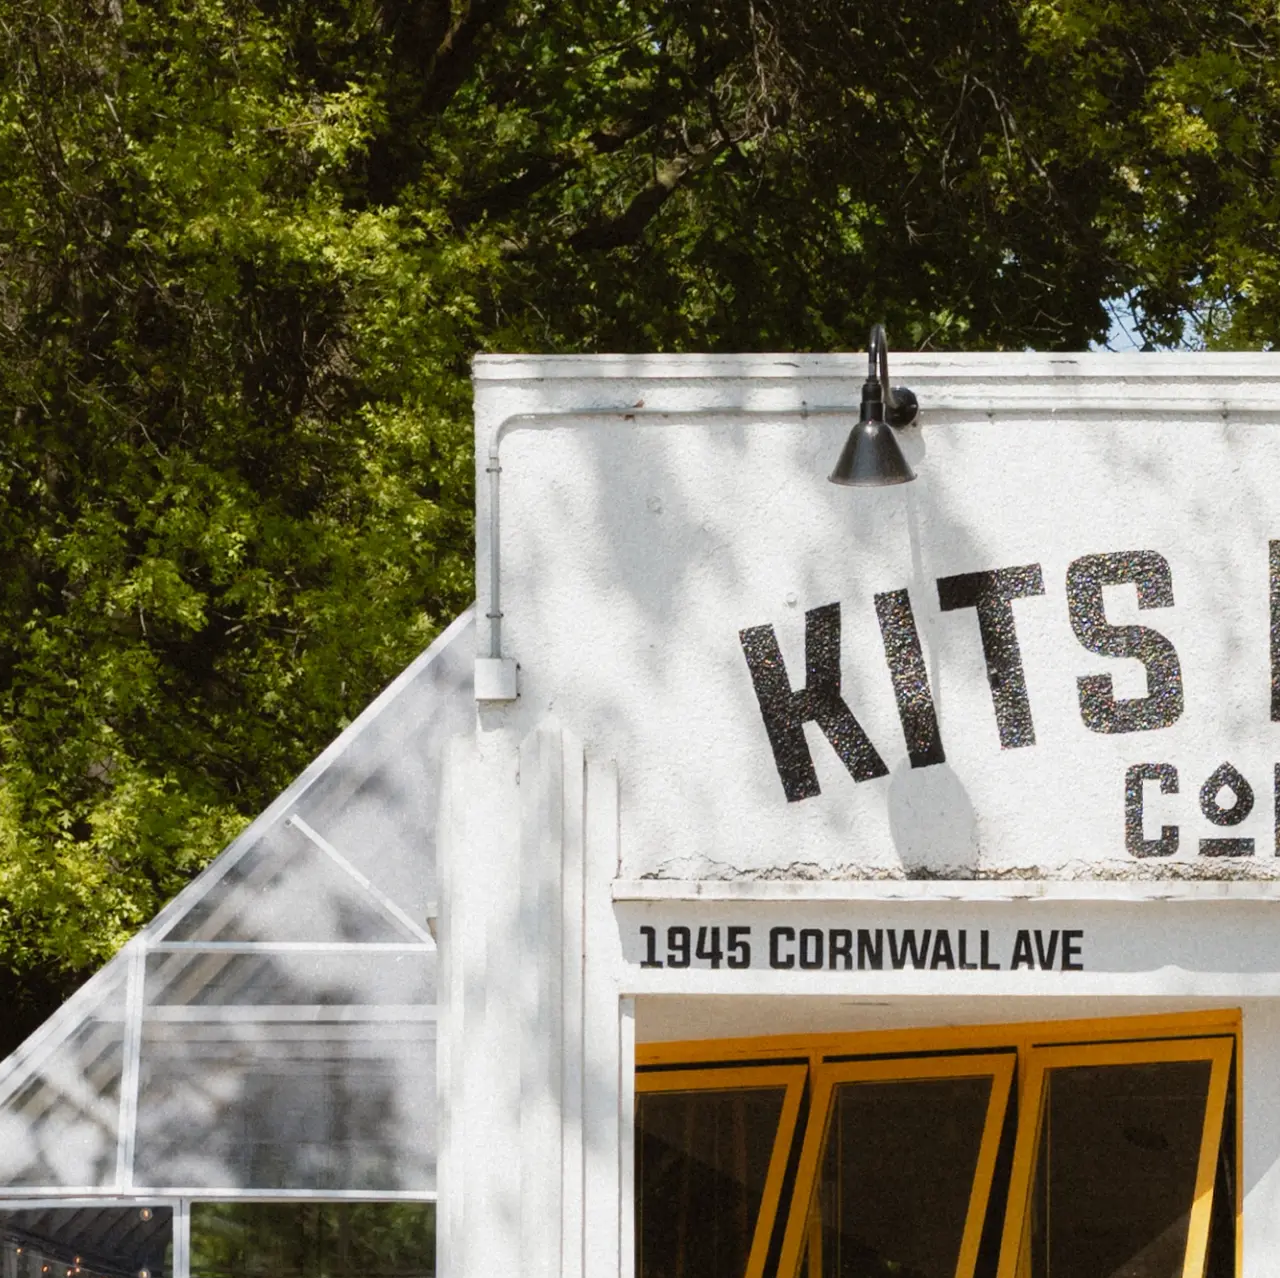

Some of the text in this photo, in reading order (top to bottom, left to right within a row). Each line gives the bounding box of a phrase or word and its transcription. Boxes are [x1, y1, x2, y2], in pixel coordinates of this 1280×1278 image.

[738, 549, 1185, 803] KITS
[639, 926, 1084, 971] 1945 CORNWALL AVE
